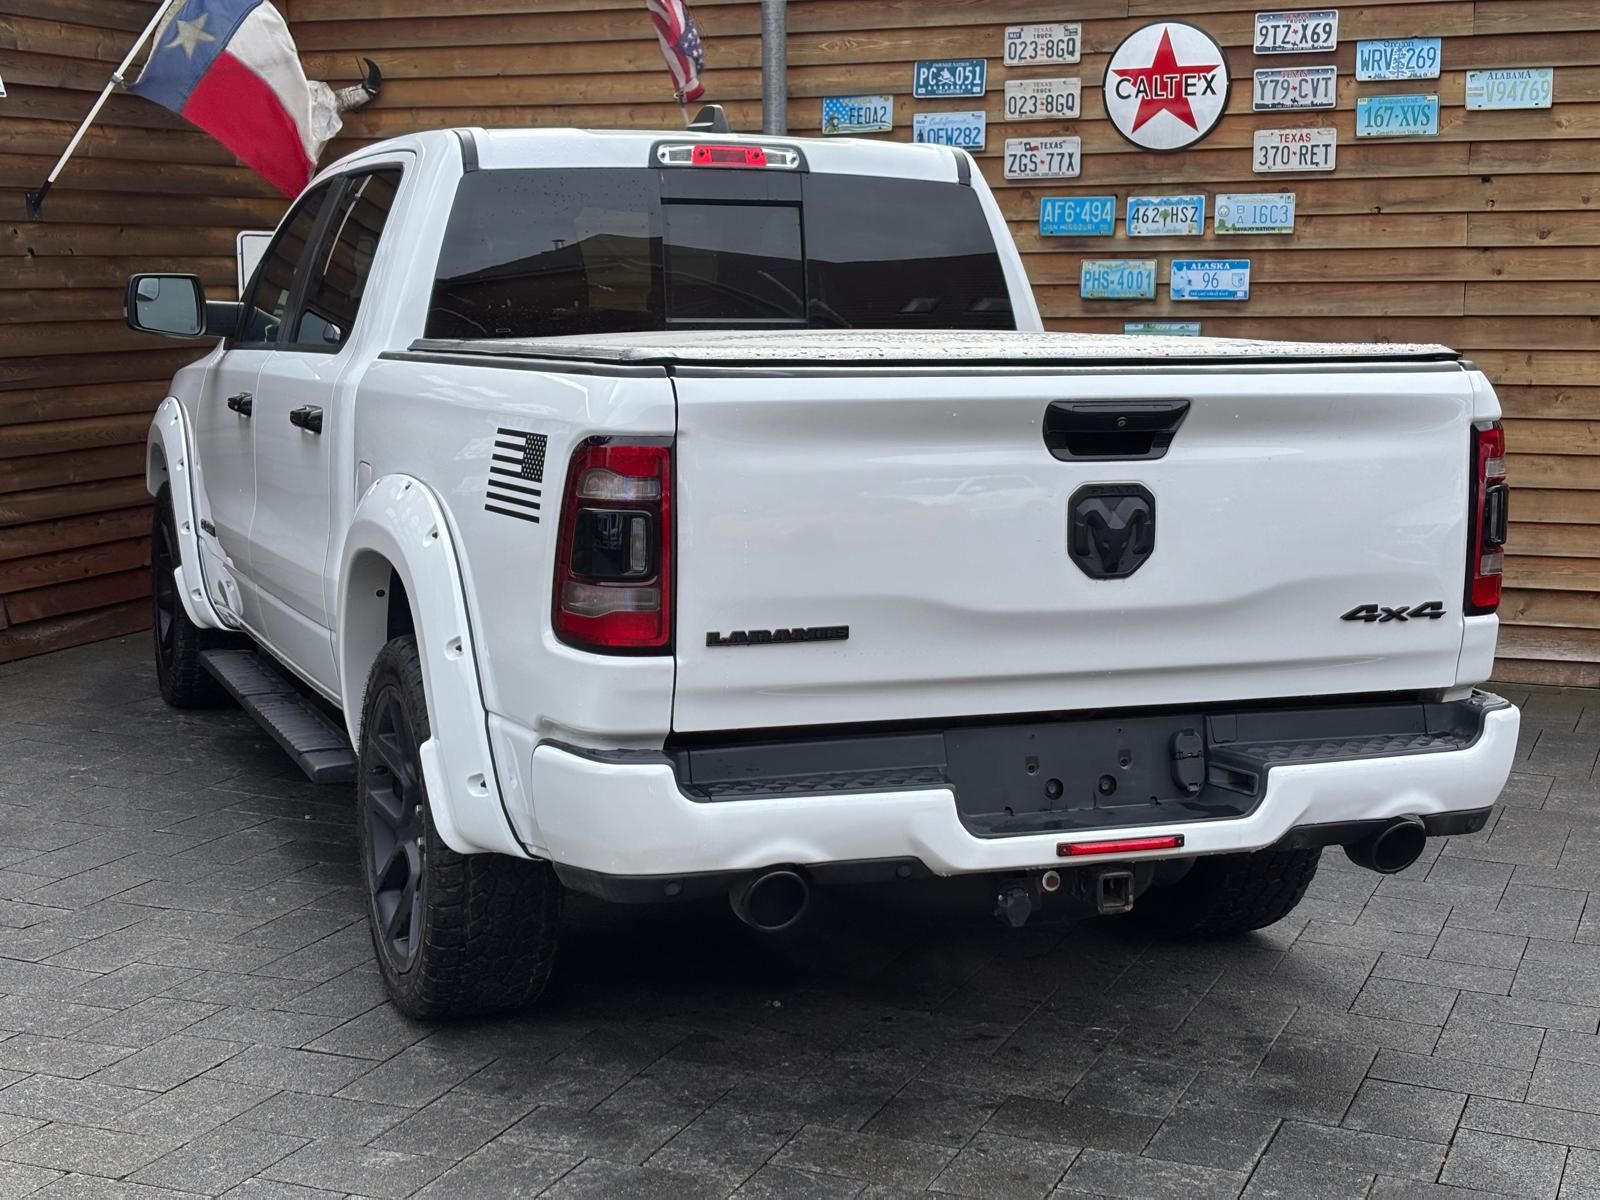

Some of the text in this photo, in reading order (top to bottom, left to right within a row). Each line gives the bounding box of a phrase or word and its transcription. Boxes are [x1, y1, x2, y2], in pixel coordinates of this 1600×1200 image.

[1487, 70, 1532, 81] ALABAMA
[1115, 73, 1218, 100] CALTEX
[1279, 132, 1312, 143] TEXAS
[1040, 142, 1064, 150] TEXAS
[1190, 262, 1231, 270] ALASKA
[1202, 271, 1219, 289] 96
[706, 625, 849, 647] LARAMIE
